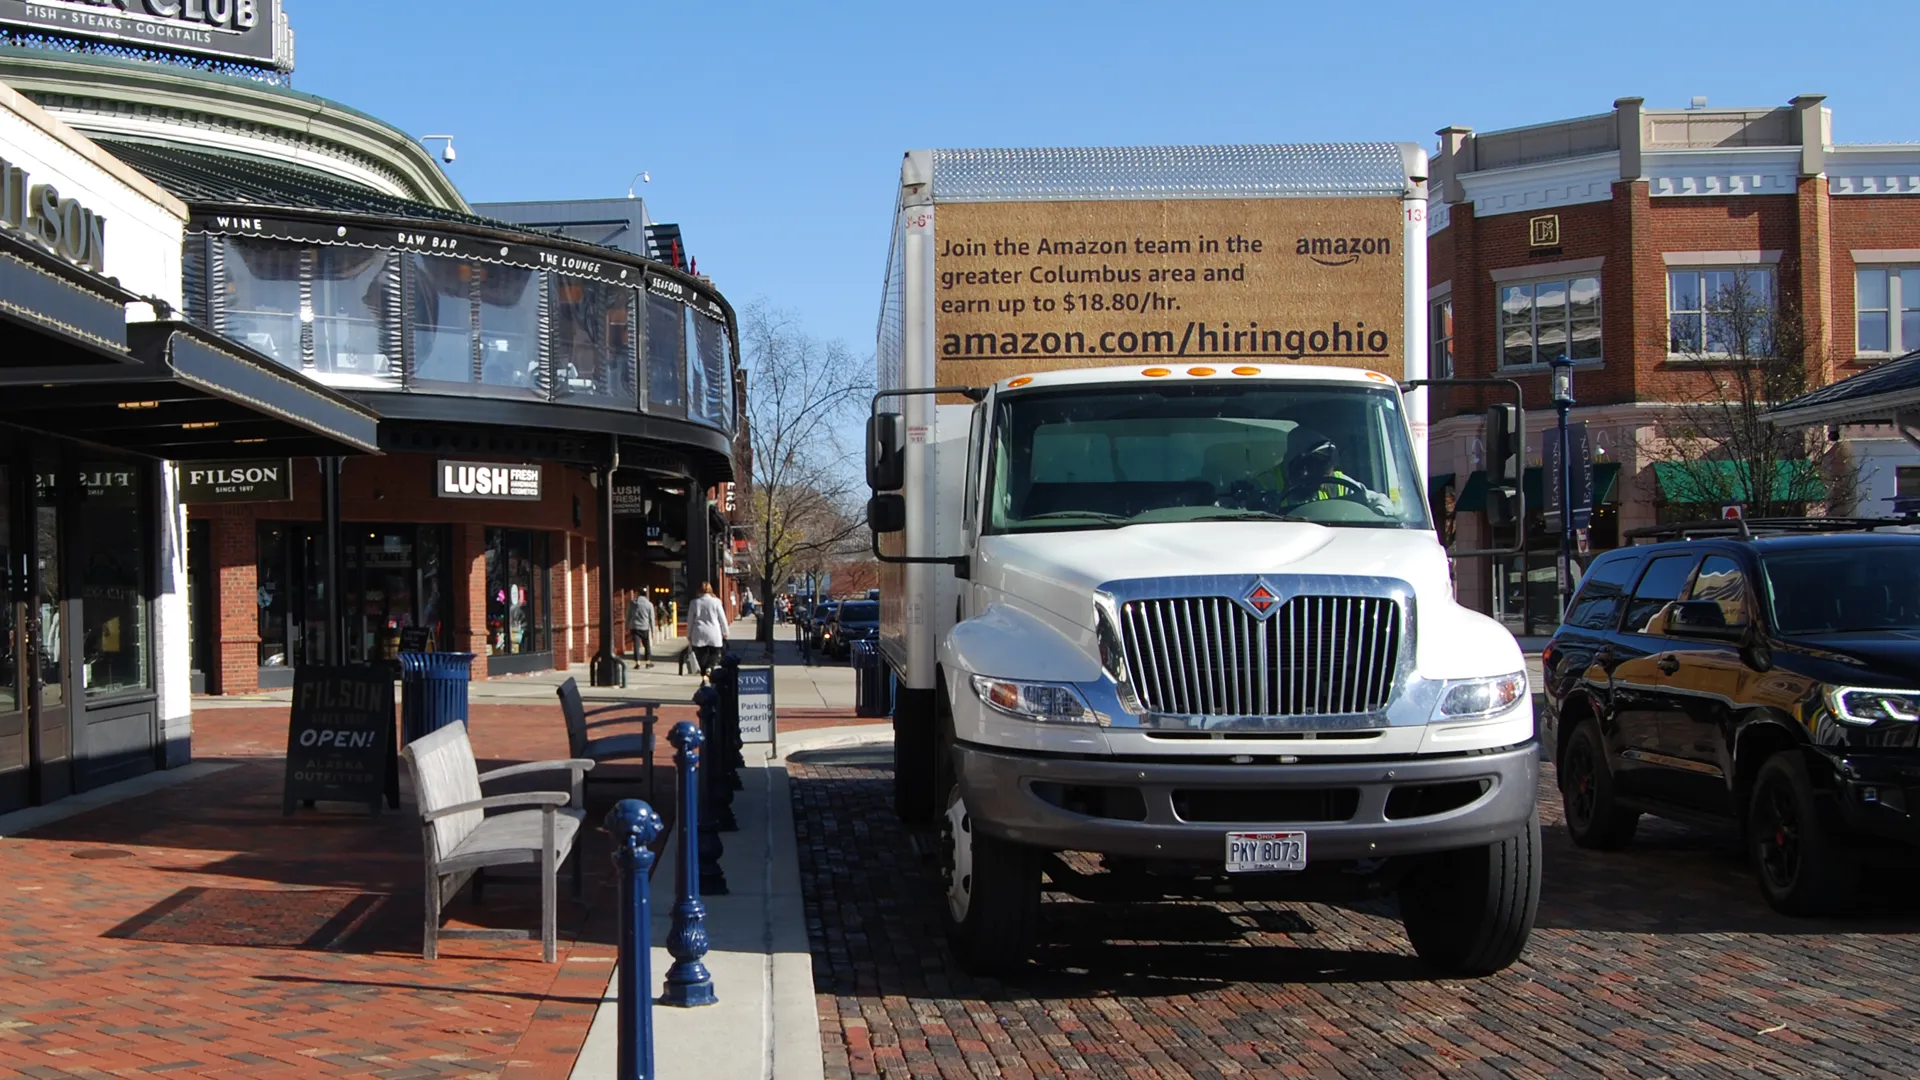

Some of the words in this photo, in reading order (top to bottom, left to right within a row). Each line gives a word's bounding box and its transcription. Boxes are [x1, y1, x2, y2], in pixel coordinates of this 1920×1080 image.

[26, 5, 57, 20] FISH
[72, 12, 122, 29] STEAKS
[136, 22, 211, 43] COCKTAILS
[217, 217, 262, 230] WINE
[398, 232, 426, 245] RAW
[432, 237, 457, 249] BAR
[941, 238, 986, 257] Join
[993, 237, 1030, 255] the
[1037, 237, 1127, 256] Amazon
[1135, 237, 1191, 254] team
[1199, 235, 1219, 253] in
[1226, 234, 1263, 253] the
[1296, 237, 1390, 255] amazon
[540, 252, 557, 266] THE
[562, 256, 600, 273] LOUNGE
[653, 277, 683, 295] SEAFOOD
[941, 268, 1022, 290] greater
[1030, 264, 1141, 284] Columbus
[1148, 267, 1196, 283] area
[1203, 263, 1245, 282] and
[941, 299, 990, 313] earn
[998, 299, 1026, 317] up
[1033, 296, 1056, 312] to
[1063, 291, 1181, 314] $18.80/hr.
[942, 321, 1388, 360] amazon.com/hiringohio
[190, 467, 278, 485] FILSON
[445, 466, 509, 495] LUSH
[510, 468, 538, 481] FRESH
[300, 679, 384, 713] FILSON
[300, 728, 376, 748] OPEN!
[1231, 842, 1259, 862] PKY
[1264, 841, 1300, 861] 8073
